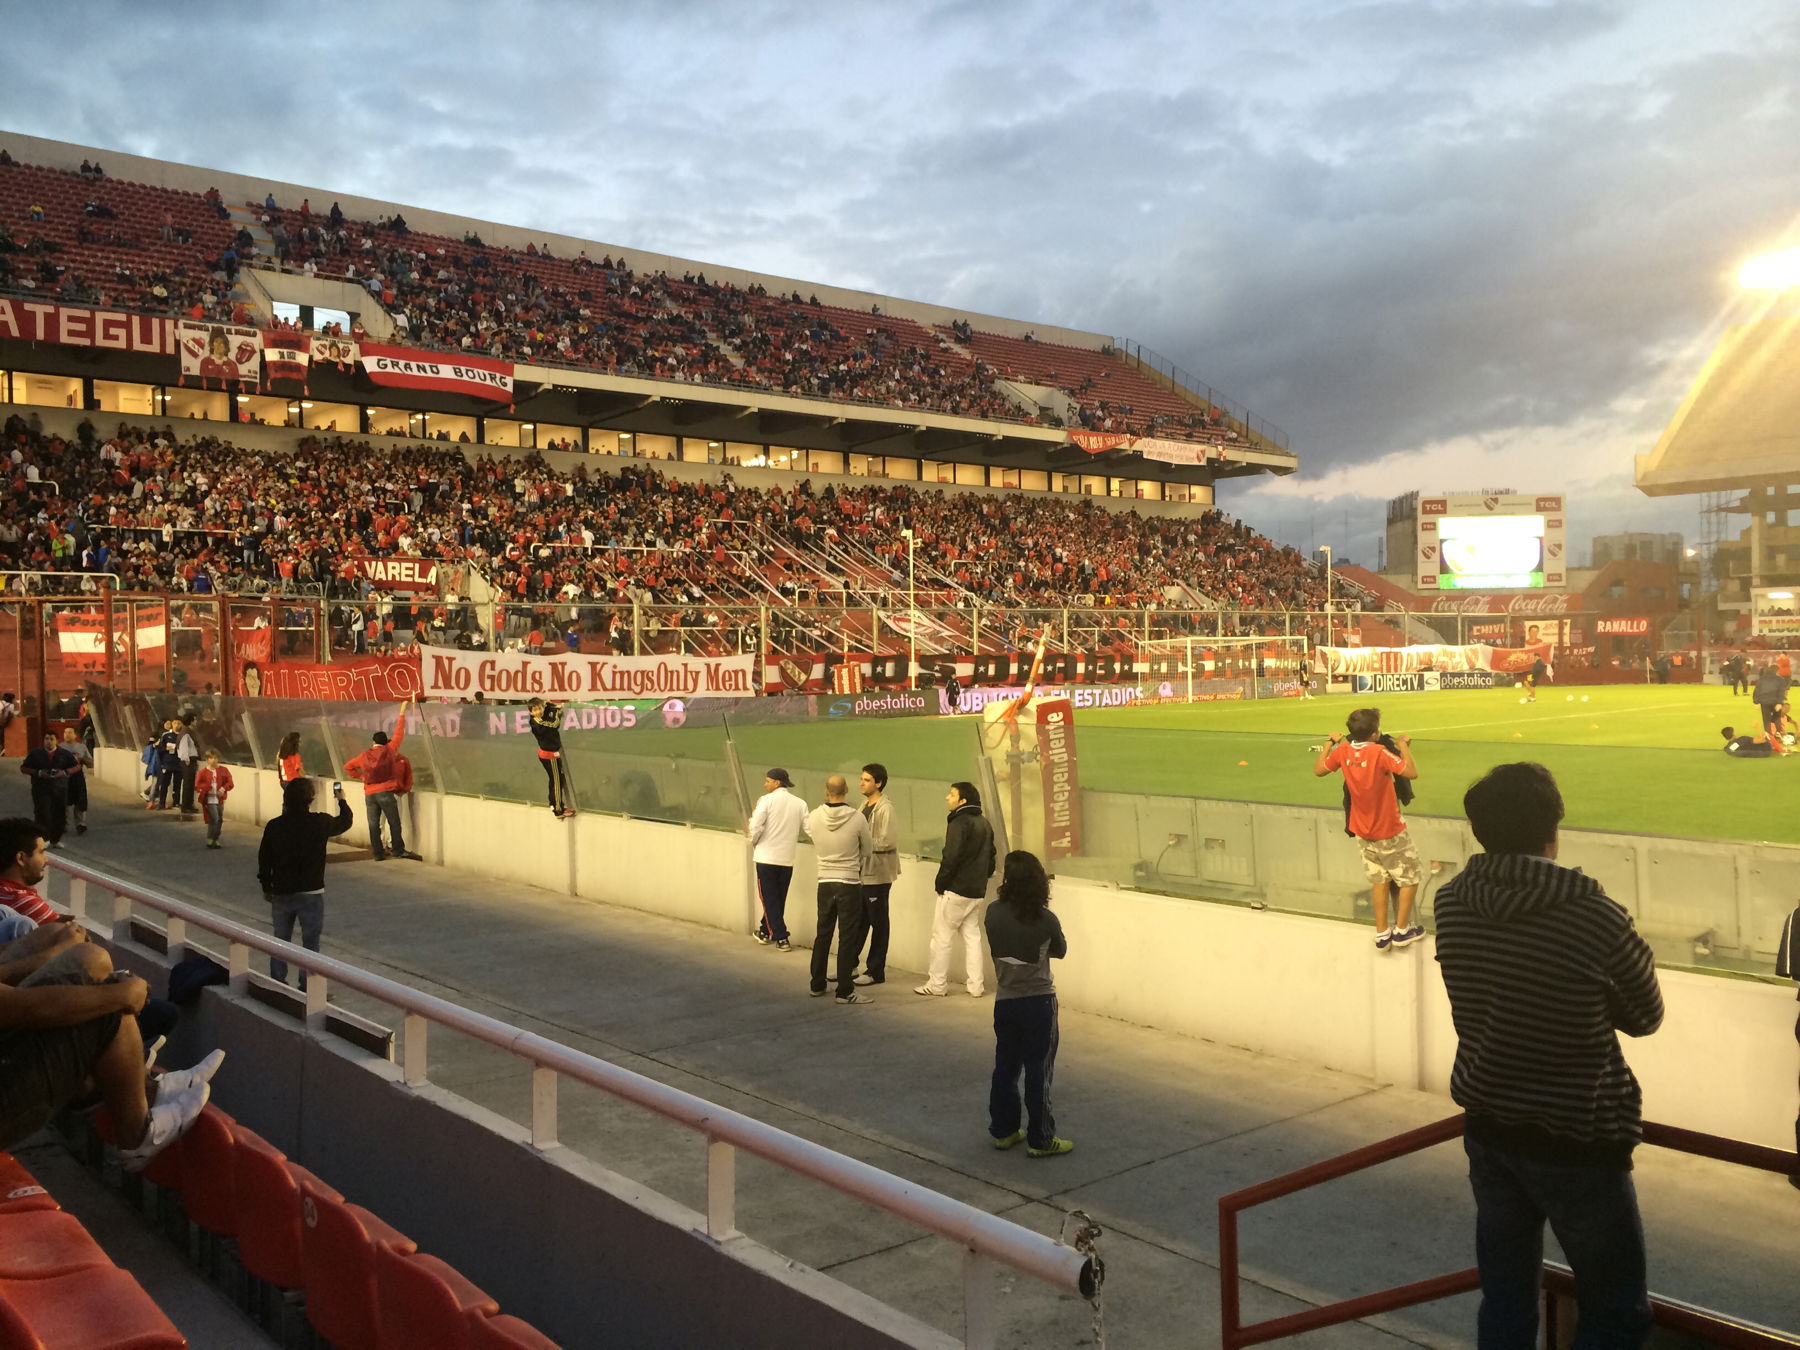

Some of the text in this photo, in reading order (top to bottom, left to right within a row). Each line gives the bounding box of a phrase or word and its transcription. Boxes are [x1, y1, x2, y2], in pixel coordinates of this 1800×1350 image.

[376, 358, 508, 388] GRAND BOURG
[364, 561, 437, 586] VARELA
[430, 654, 471, 691] No
[478, 660, 546, 694] Gods,
[548, 661, 581, 692] No
[656, 662, 701, 695] Only
[704, 662, 749, 692] Men
[1376, 675, 1420, 691] DIRECTV
[855, 693, 925, 715] pbestatica
[1075, 686, 1143, 707] ESTADIOS
[1047, 711, 1072, 827] Independiente
